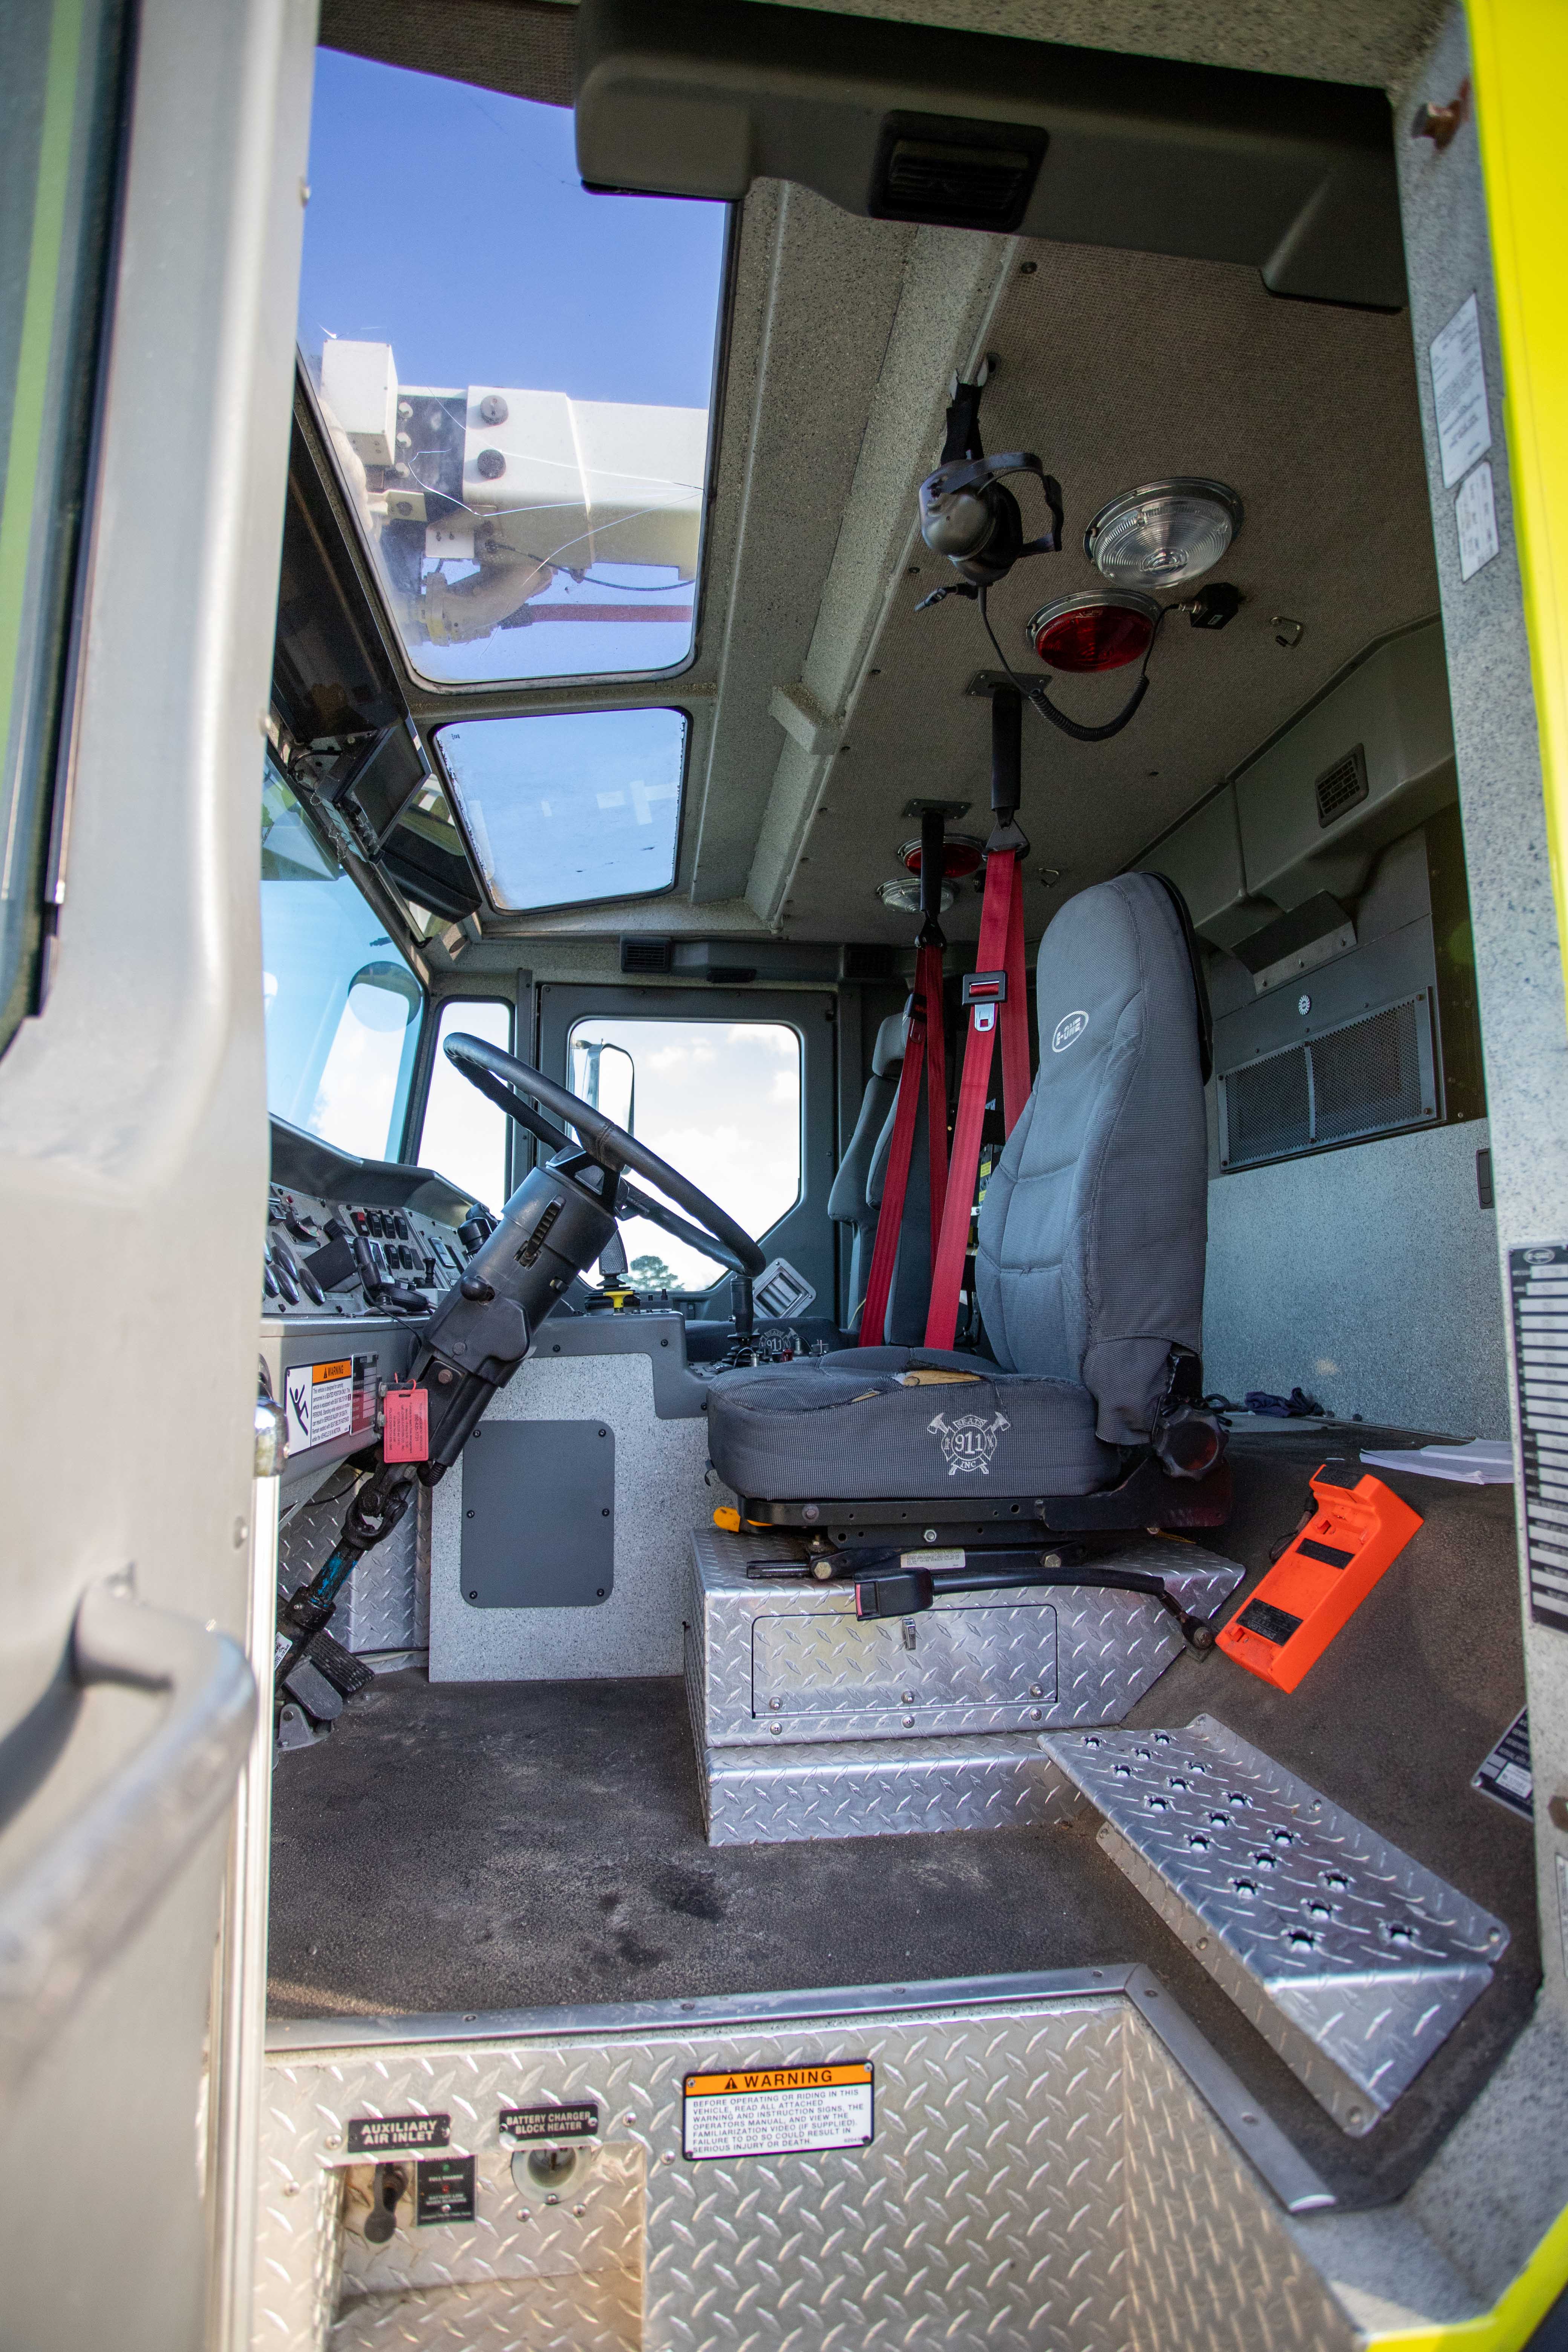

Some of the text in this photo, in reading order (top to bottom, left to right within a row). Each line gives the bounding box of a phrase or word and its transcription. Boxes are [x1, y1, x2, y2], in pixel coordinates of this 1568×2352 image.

[766, 1338, 782, 1352] 911
[327, 1364, 343, 1377] WARNING
[955, 1432, 983, 1454] 911
[744, 2070, 832, 2088] WARNING
[693, 2099, 727, 2107] BEFORE
[730, 2095, 779, 2105] OPERATING
[693, 2106, 732, 2116] VEHICLE,
[778, 2099, 823, 2109] ATTACHED
[506, 2110, 591, 2126] BATTERY CHARGER
[693, 2113, 734, 2122] WARNING
[757, 2107, 814, 2118] INSTRUCTION
[361, 2119, 437, 2135] AUXILIARY
[515, 2120, 582, 2135] BLOCK HEATER
[693, 2120, 745, 2130] OPERATORS
[748, 2117, 786, 2127] MANUAL,
[693, 2126, 767, 2138] FAMILIARIZATION
[812, 2119, 858, 2130] SUPPLIED).
[363, 2130, 434, 2145] AIR INLET
[693, 2137, 729, 2146] FAILURE
[775, 2131, 805, 2139] COULD
[807, 2128, 839, 2137] RESULT
[693, 2144, 730, 2154] SERIOUS
[733, 2142, 764, 2150] INJURY
[782, 2138, 812, 2146] DEATH.
